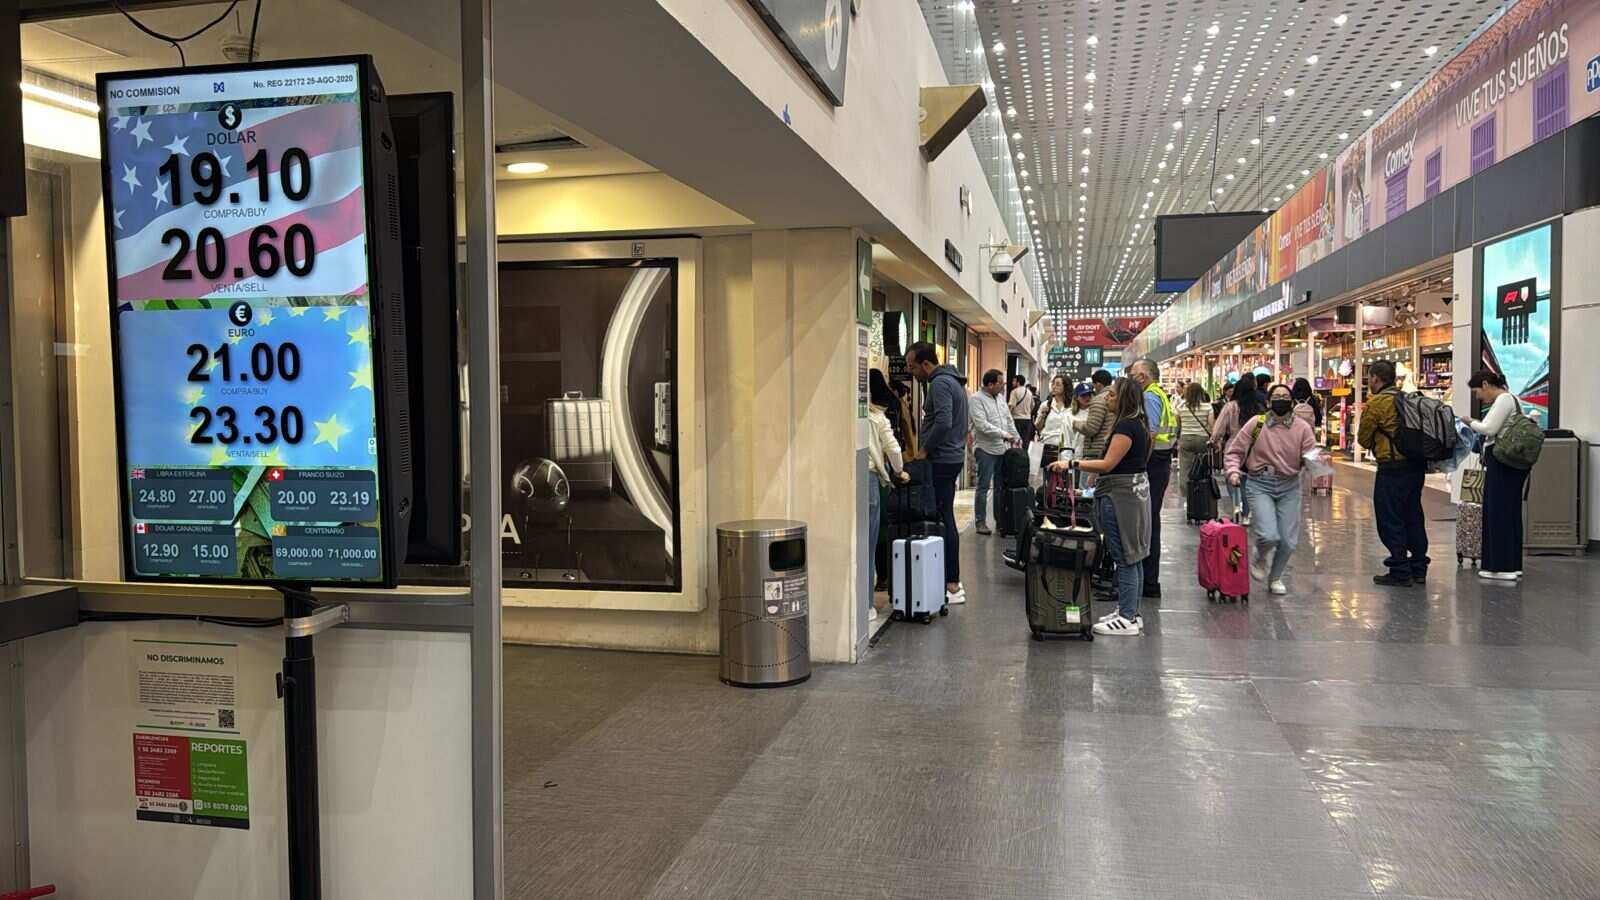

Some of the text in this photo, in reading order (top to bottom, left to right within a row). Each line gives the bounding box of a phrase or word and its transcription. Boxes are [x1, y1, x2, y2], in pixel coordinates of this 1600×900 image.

[1456, 22, 1569, 128] VIVE TUS SUEÑOS
[110, 86, 180, 99] NO COMMISION
[207, 130, 256, 145] DOLAR
[159, 147, 312, 206] 19.10
[204, 207, 267, 219] COMPRA/BUY
[161, 223, 316, 280] 20.60
[211, 283, 268, 293] VENTA/SELL
[228, 328, 255, 337] EURO
[186, 342, 301, 382] 21.00
[190, 405, 304, 444] 23.30
[139, 490, 226, 504] 24.80 27.00
[278, 491, 370, 505] 20.00 23.19
[143, 544, 229, 558] 12.90 15.00
[276, 548, 376, 560] 69,000.00 71,000.00
[161, 655, 224, 665] DISCRIMINAMOS
[191, 743, 242, 754] REPORTES
